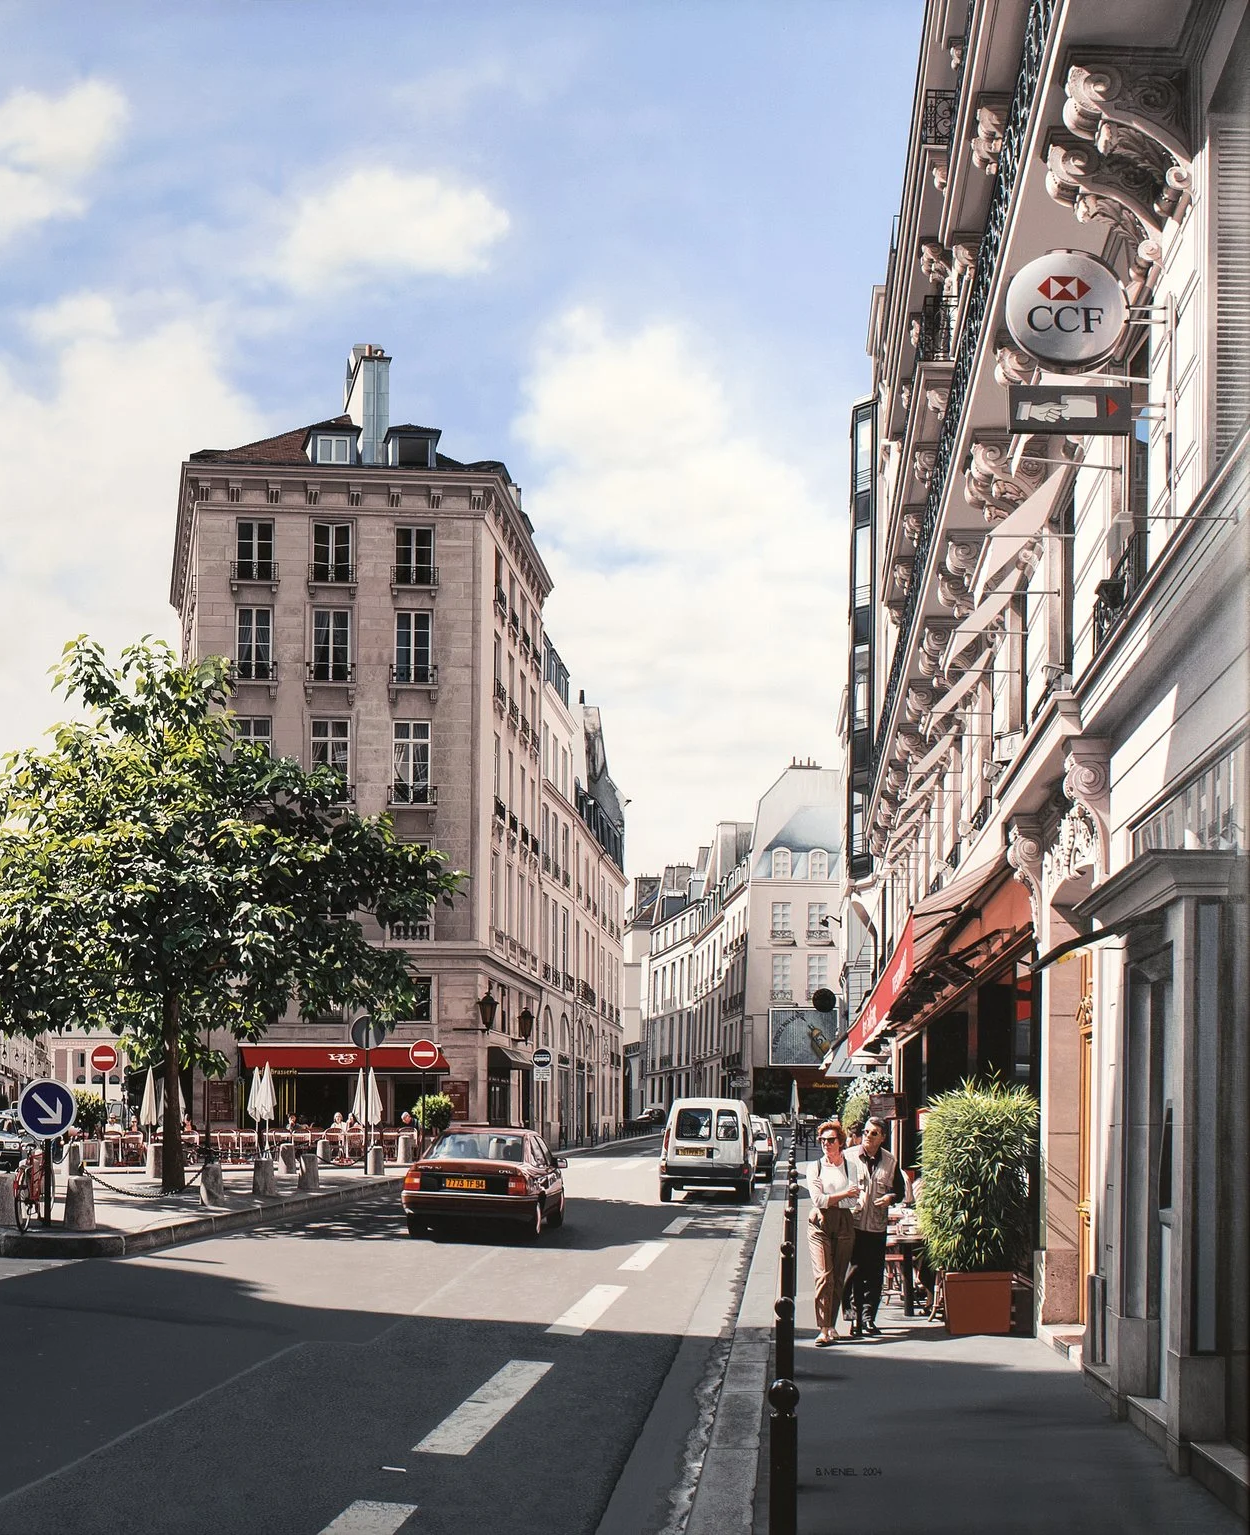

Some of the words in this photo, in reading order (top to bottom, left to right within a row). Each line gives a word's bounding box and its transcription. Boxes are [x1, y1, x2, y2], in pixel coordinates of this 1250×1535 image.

[1027, 305, 1103, 333] CCF
[476, 1181, 485, 1189] 94
[863, 1467, 882, 1477] 2004
